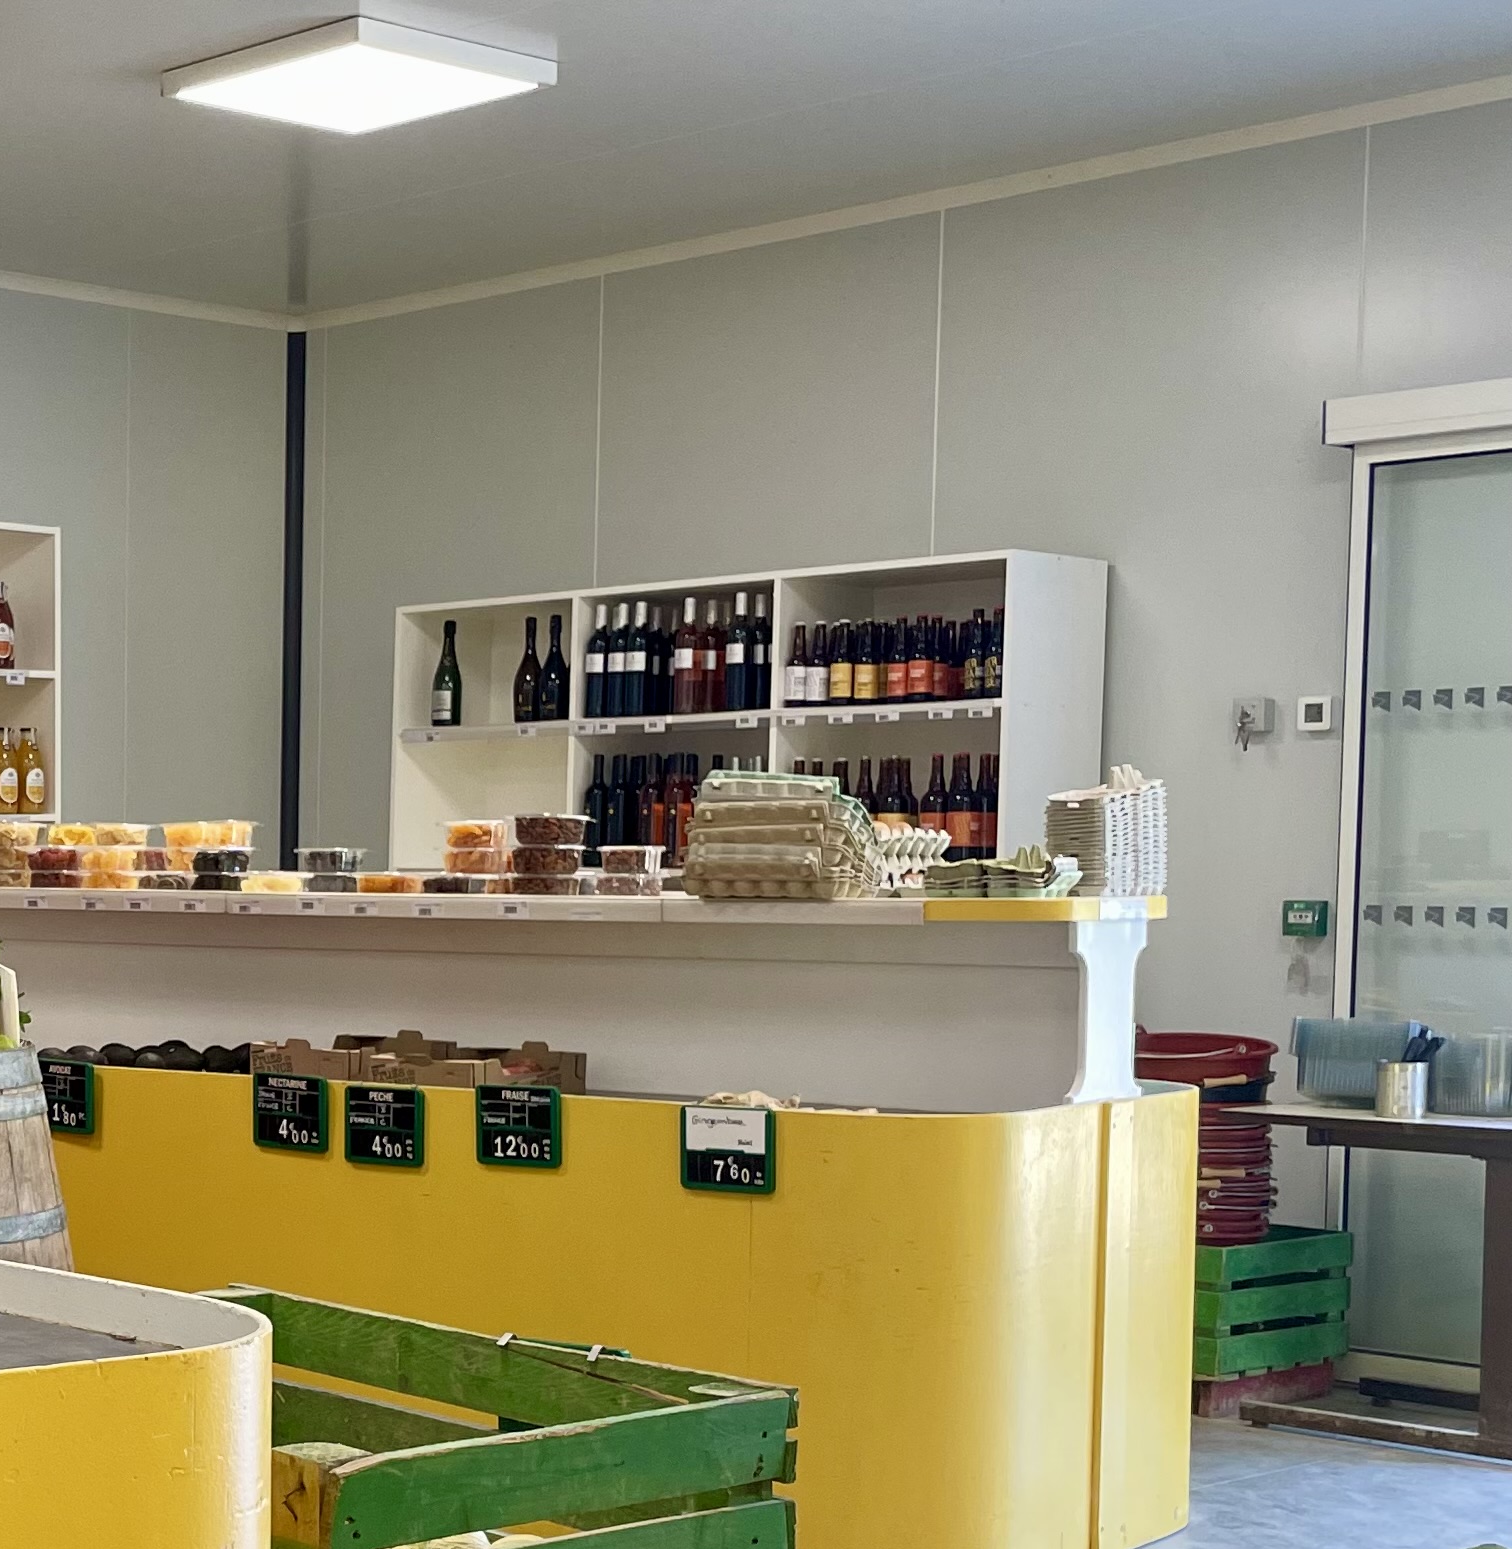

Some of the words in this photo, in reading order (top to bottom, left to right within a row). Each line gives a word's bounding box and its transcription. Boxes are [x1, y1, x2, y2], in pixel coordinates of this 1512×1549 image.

[49, 1064, 72, 1075] AVOCAT
[268, 1077, 307, 1090] NECTARINE
[501, 1090, 530, 1101] FRAISE
